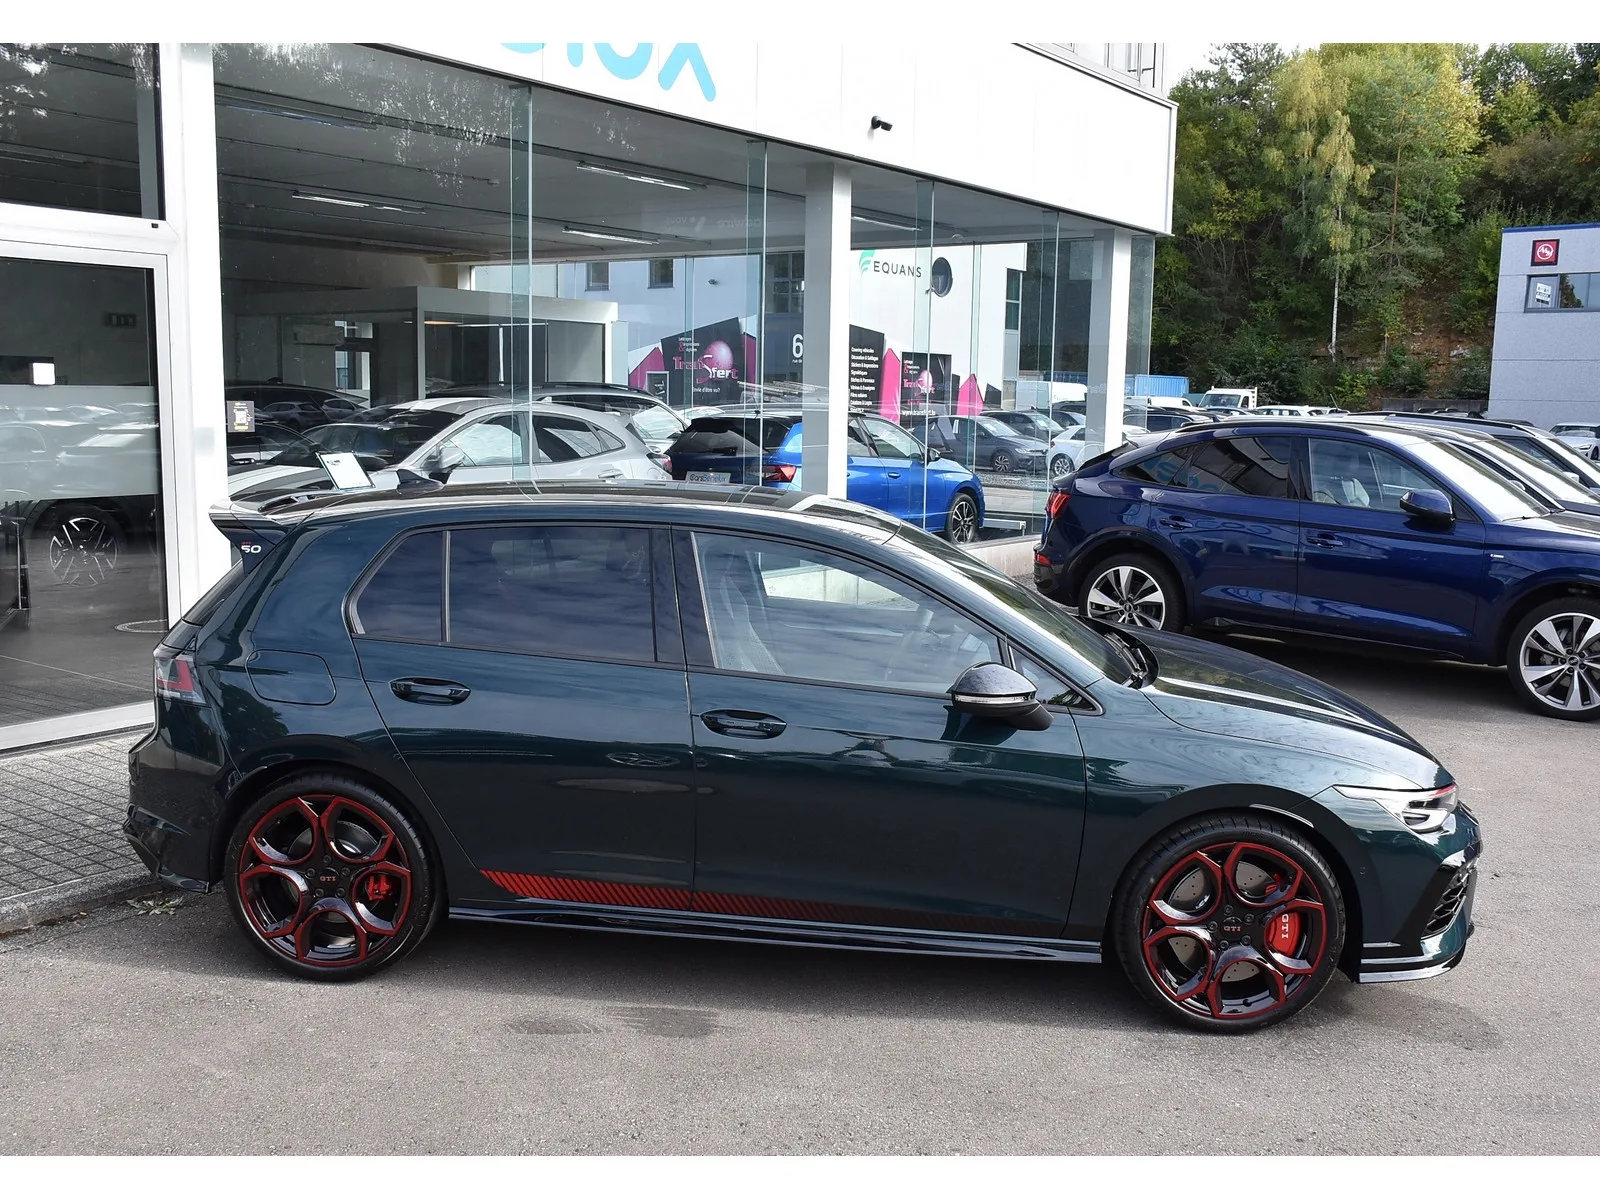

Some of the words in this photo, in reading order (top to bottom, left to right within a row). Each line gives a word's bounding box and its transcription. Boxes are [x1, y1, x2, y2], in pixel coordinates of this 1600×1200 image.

[874, 261, 922, 278] EQUANS
[792, 333, 804, 358] 6
[241, 545, 261, 553] 50
[1281, 914, 1289, 939] GTI
